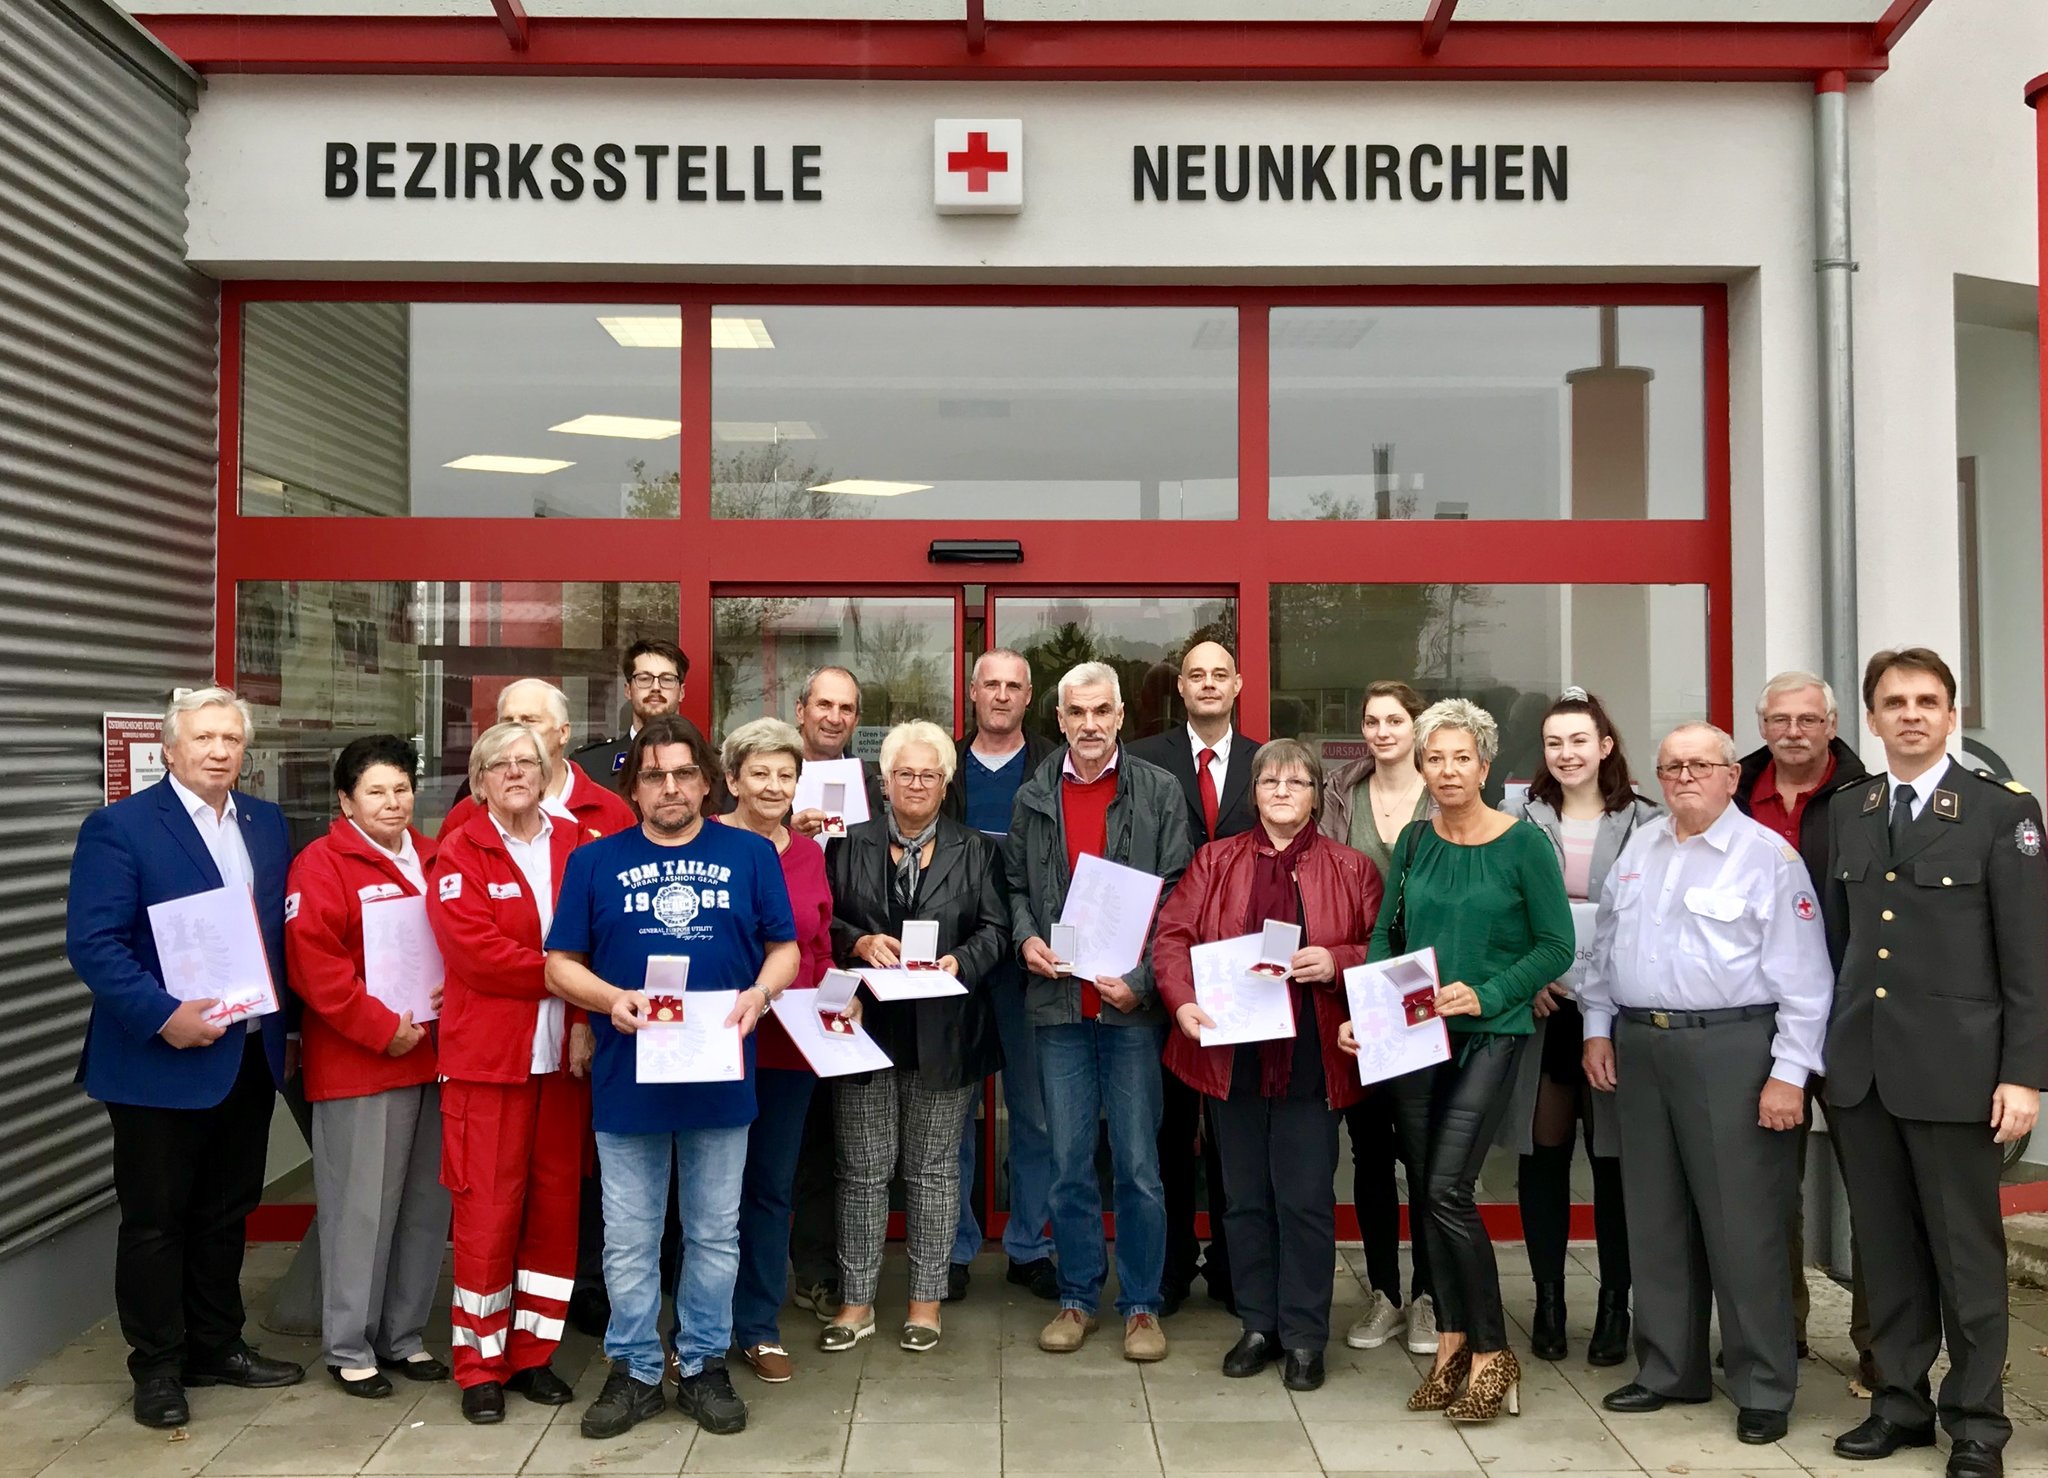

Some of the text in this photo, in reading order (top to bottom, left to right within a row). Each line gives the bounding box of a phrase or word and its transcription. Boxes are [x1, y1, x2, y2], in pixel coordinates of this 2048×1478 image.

[325, 141, 1568, 201] BEZIRKSSTELLE NEUNKIRCHEN
[616, 859, 731, 887] TOM TAILOR
[630, 877, 658, 889] URBAN
[697, 876, 719, 886] GEAR
[623, 892, 650, 913] 19
[701, 889, 730, 909] 62
[638, 927, 665, 935] GENERAL
